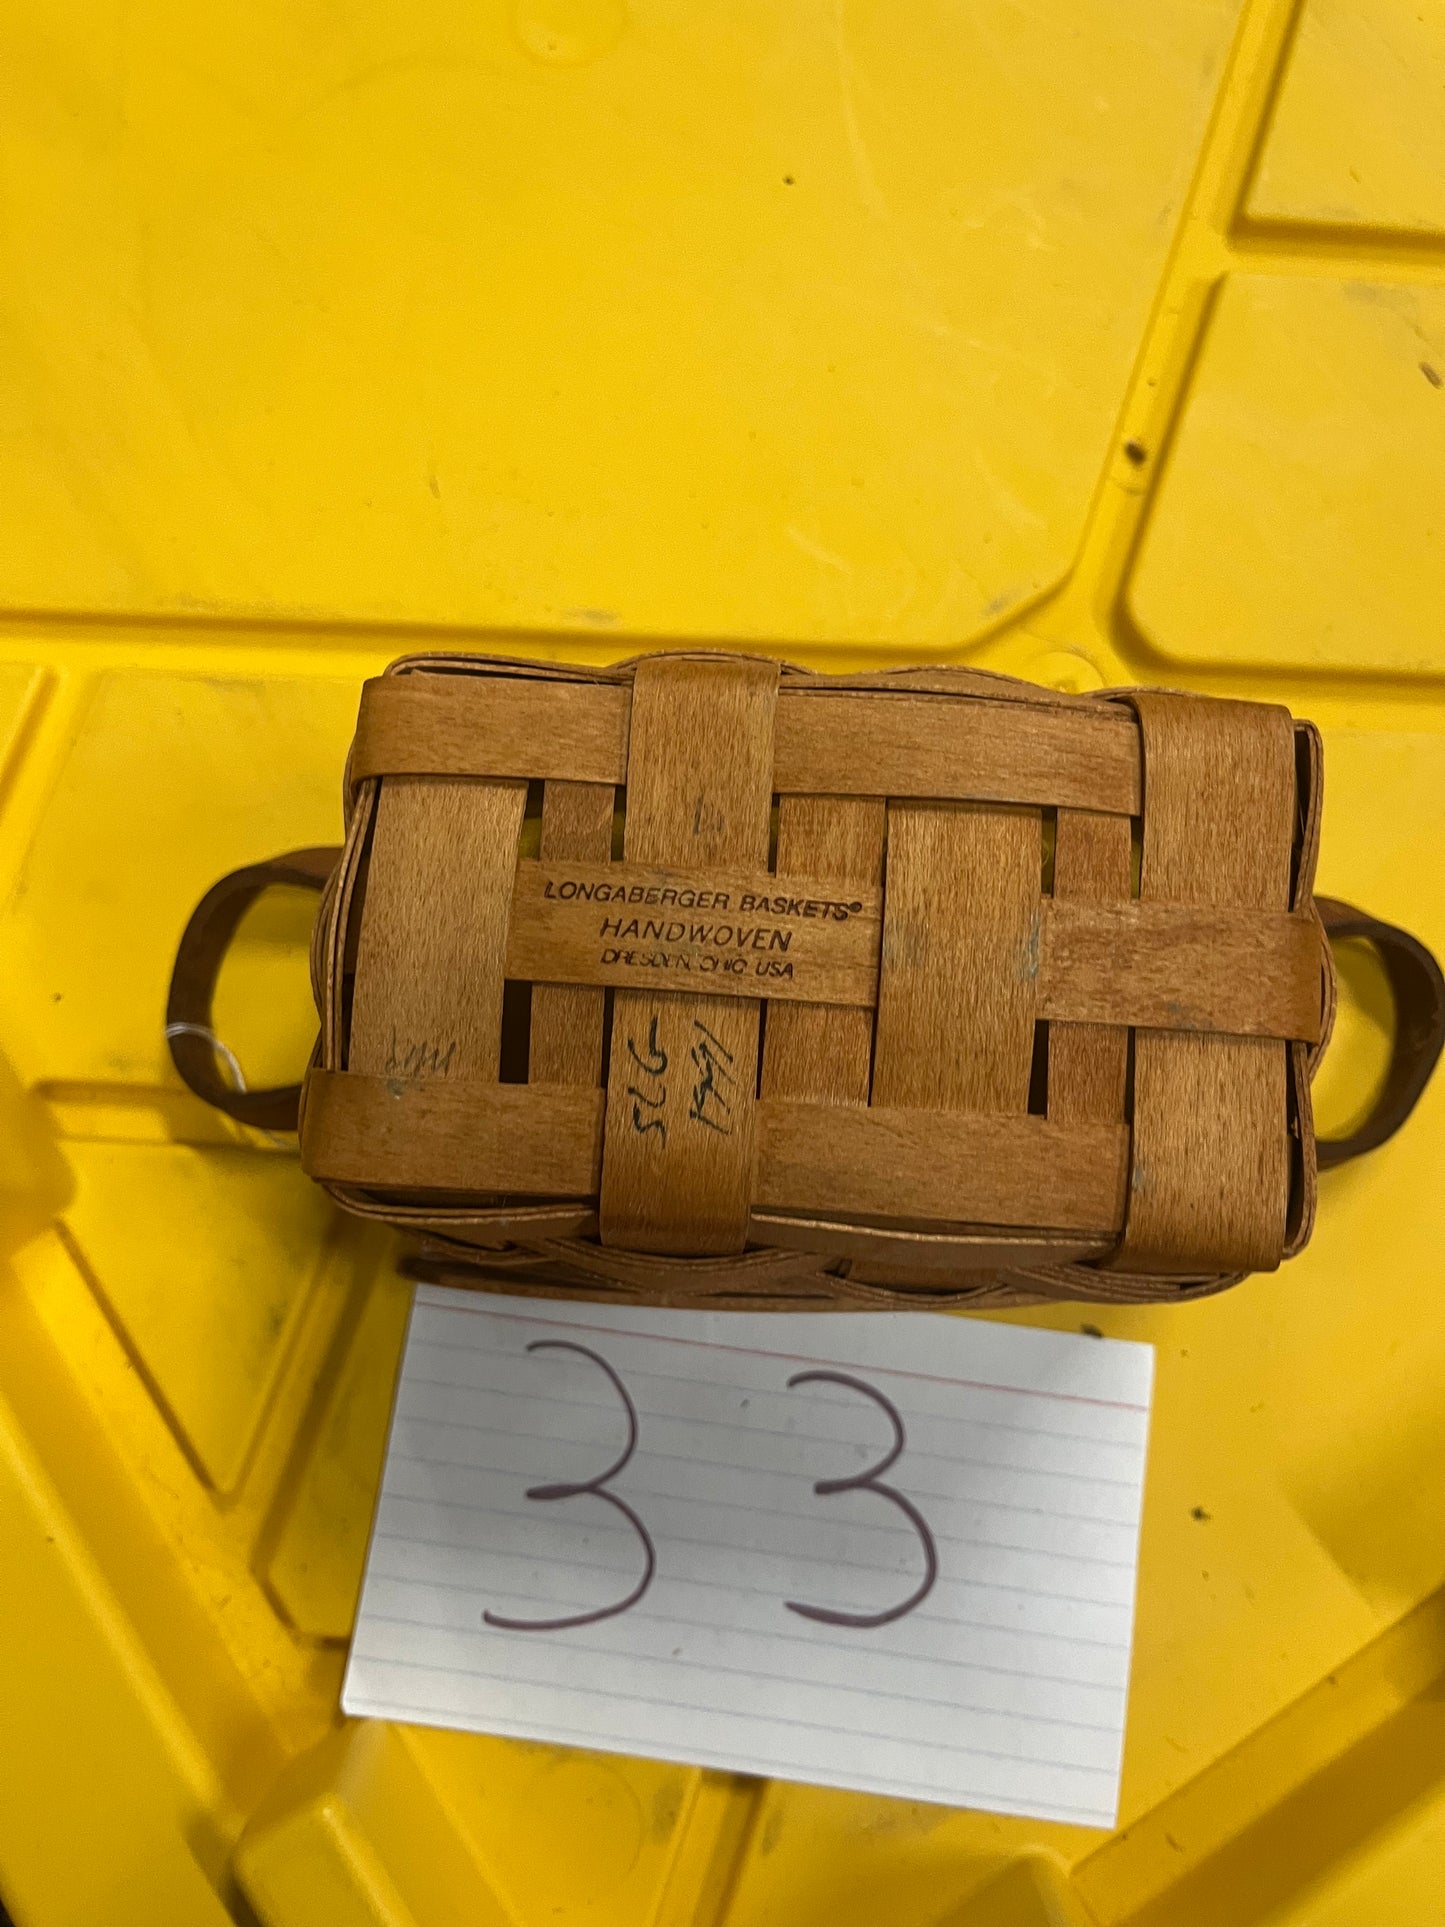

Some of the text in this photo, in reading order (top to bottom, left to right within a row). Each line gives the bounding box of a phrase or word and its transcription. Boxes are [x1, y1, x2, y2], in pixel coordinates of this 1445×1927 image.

[544, 880, 730, 910] LONGABERGER
[599, 917, 793, 952] HANDWOVEN
[755, 960, 795, 979] USA
